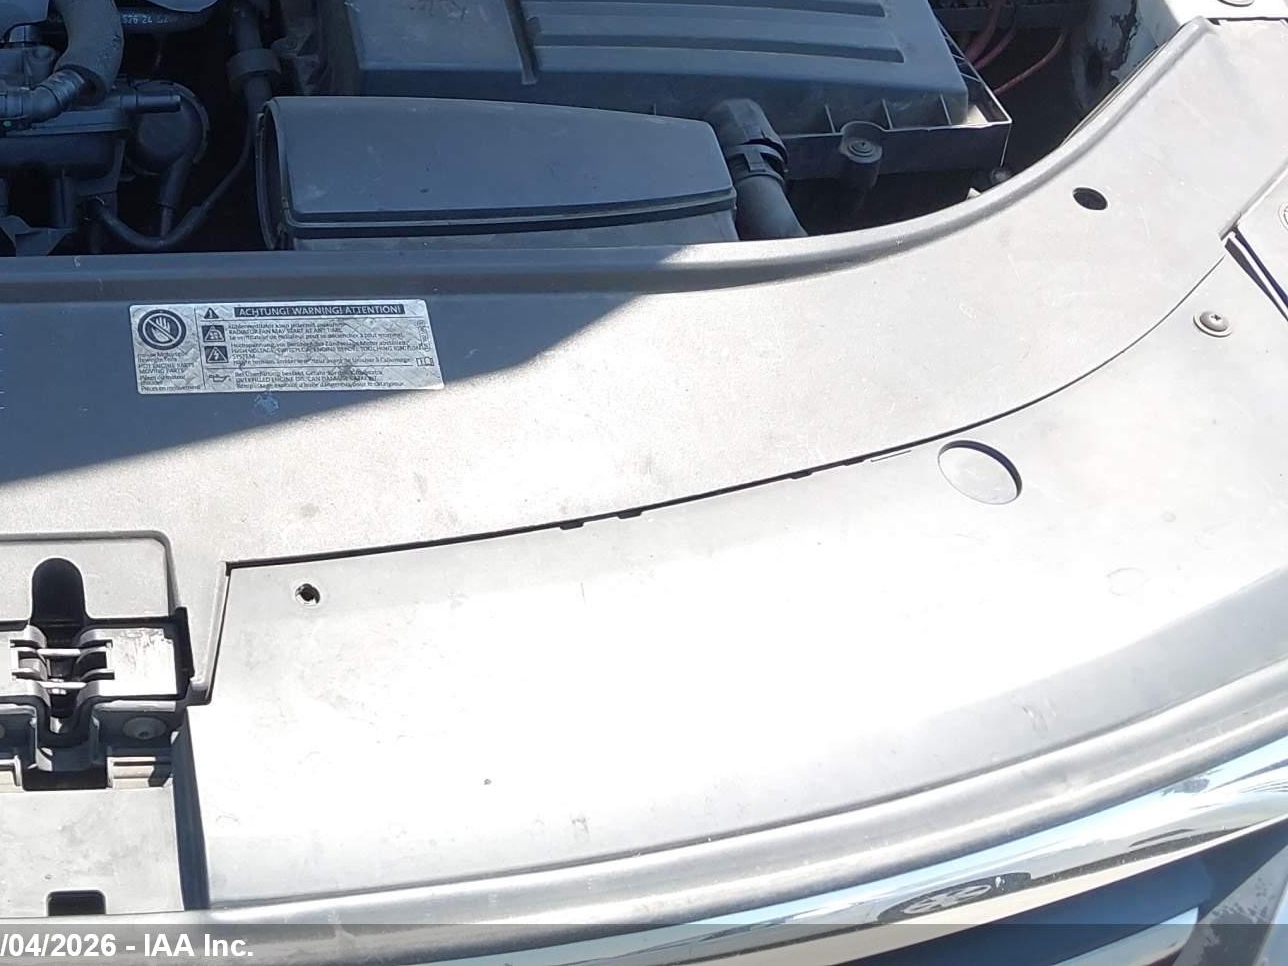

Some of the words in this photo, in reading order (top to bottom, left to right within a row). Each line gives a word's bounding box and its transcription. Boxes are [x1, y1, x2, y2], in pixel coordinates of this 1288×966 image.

[239, 308, 290, 316] ACHTUNG!
[292, 306, 343, 315] WARNING!
[344, 305, 401, 314] ATTENTION!
